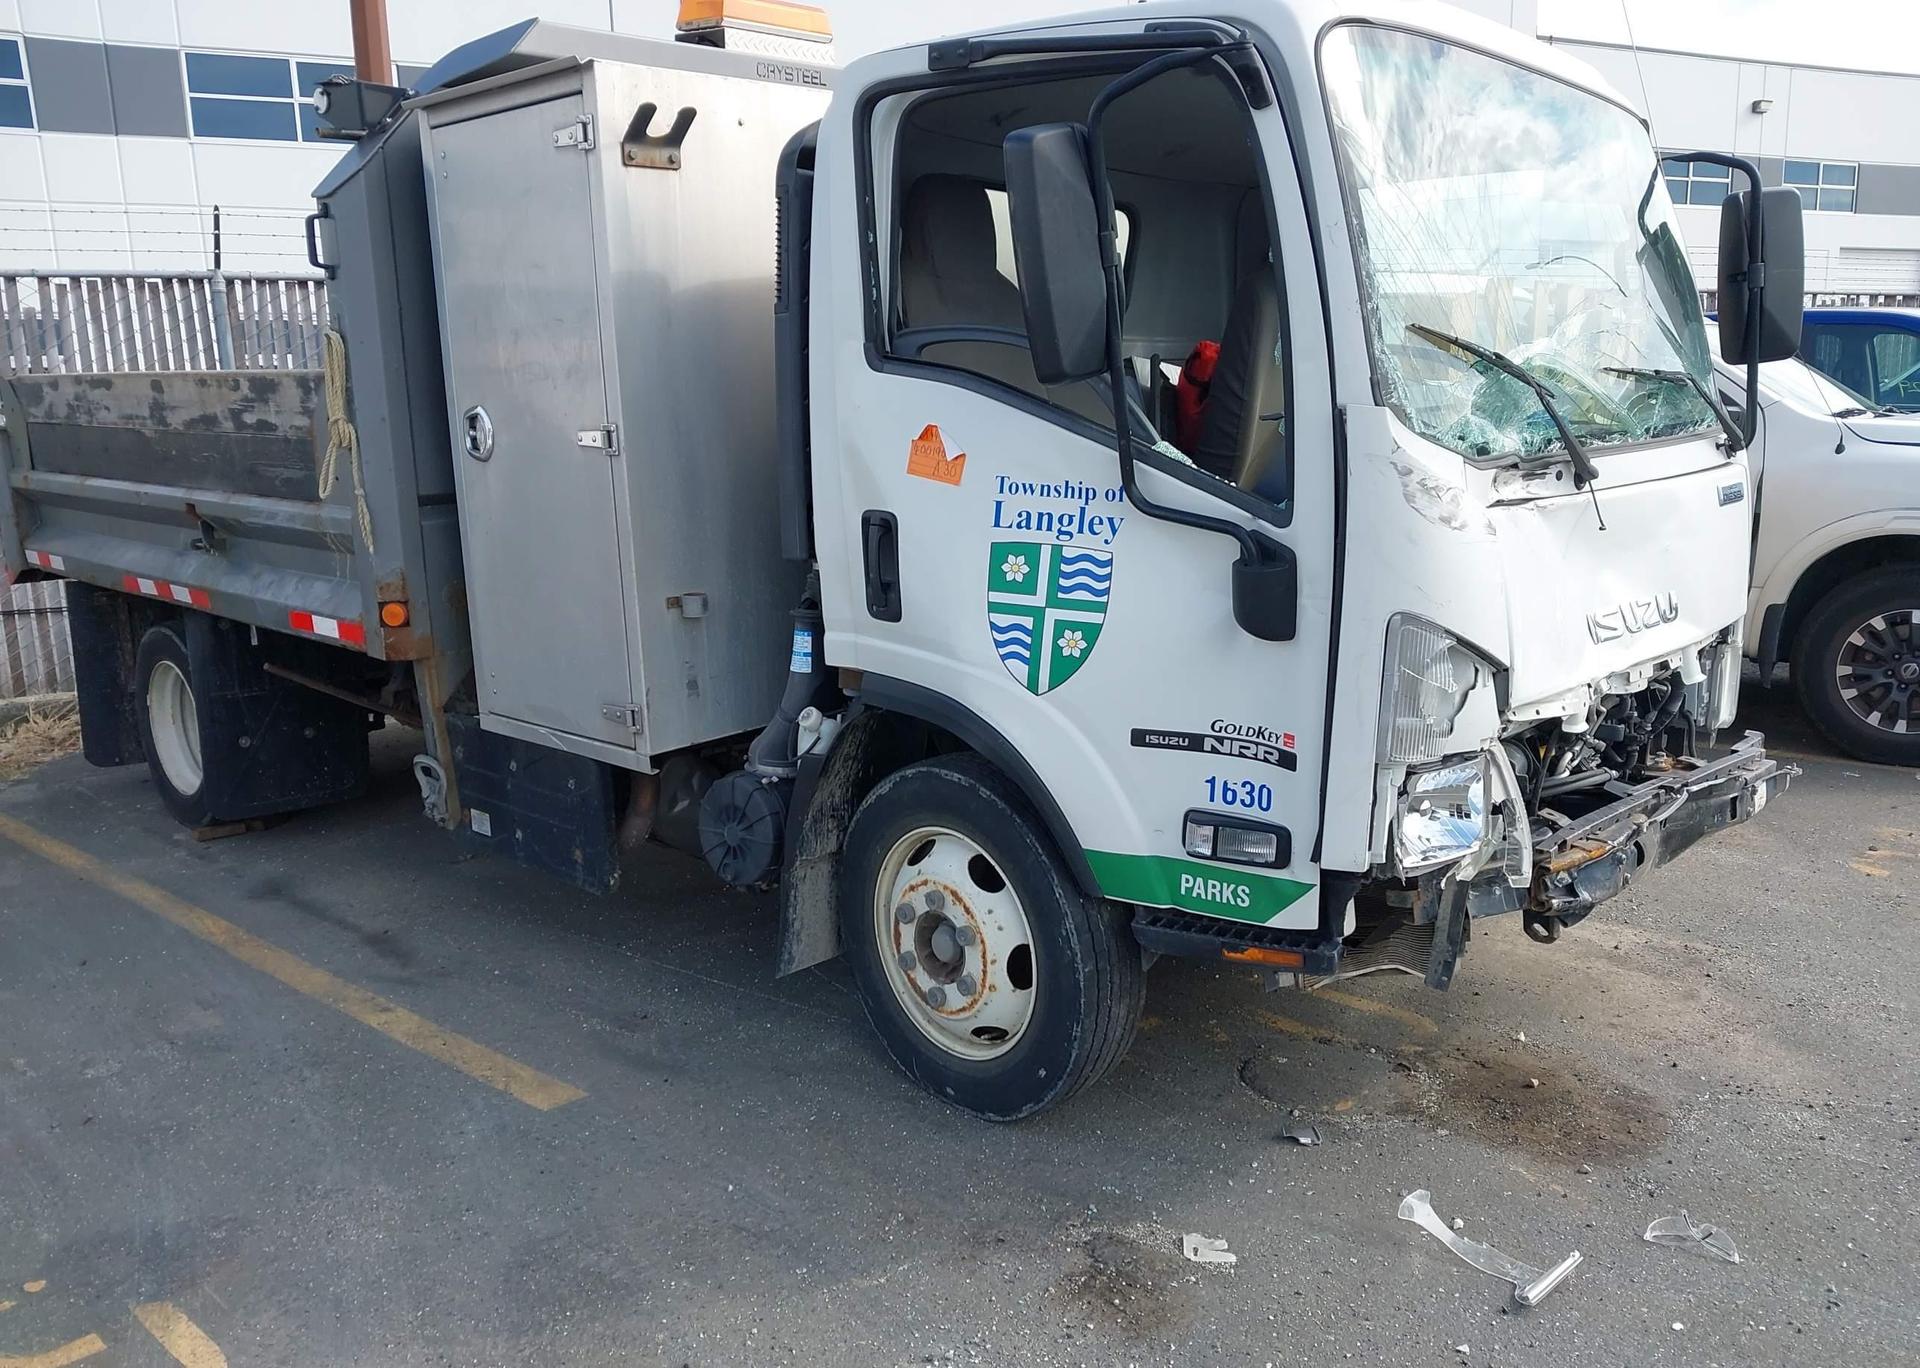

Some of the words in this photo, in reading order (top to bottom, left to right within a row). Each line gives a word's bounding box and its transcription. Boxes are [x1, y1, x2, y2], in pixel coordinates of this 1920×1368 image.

[756, 62, 827, 86] CRYSTEEL
[995, 475, 1097, 506] Township
[1104, 485, 1125, 502] of
[992, 500, 1125, 545] Langley
[1586, 592, 1678, 645] ISUZU
[1145, 734, 1189, 746] ISUZU
[1203, 737, 1280, 764] NRR
[1205, 776, 1272, 812] 1630
[1180, 873, 1250, 907] PARKS
